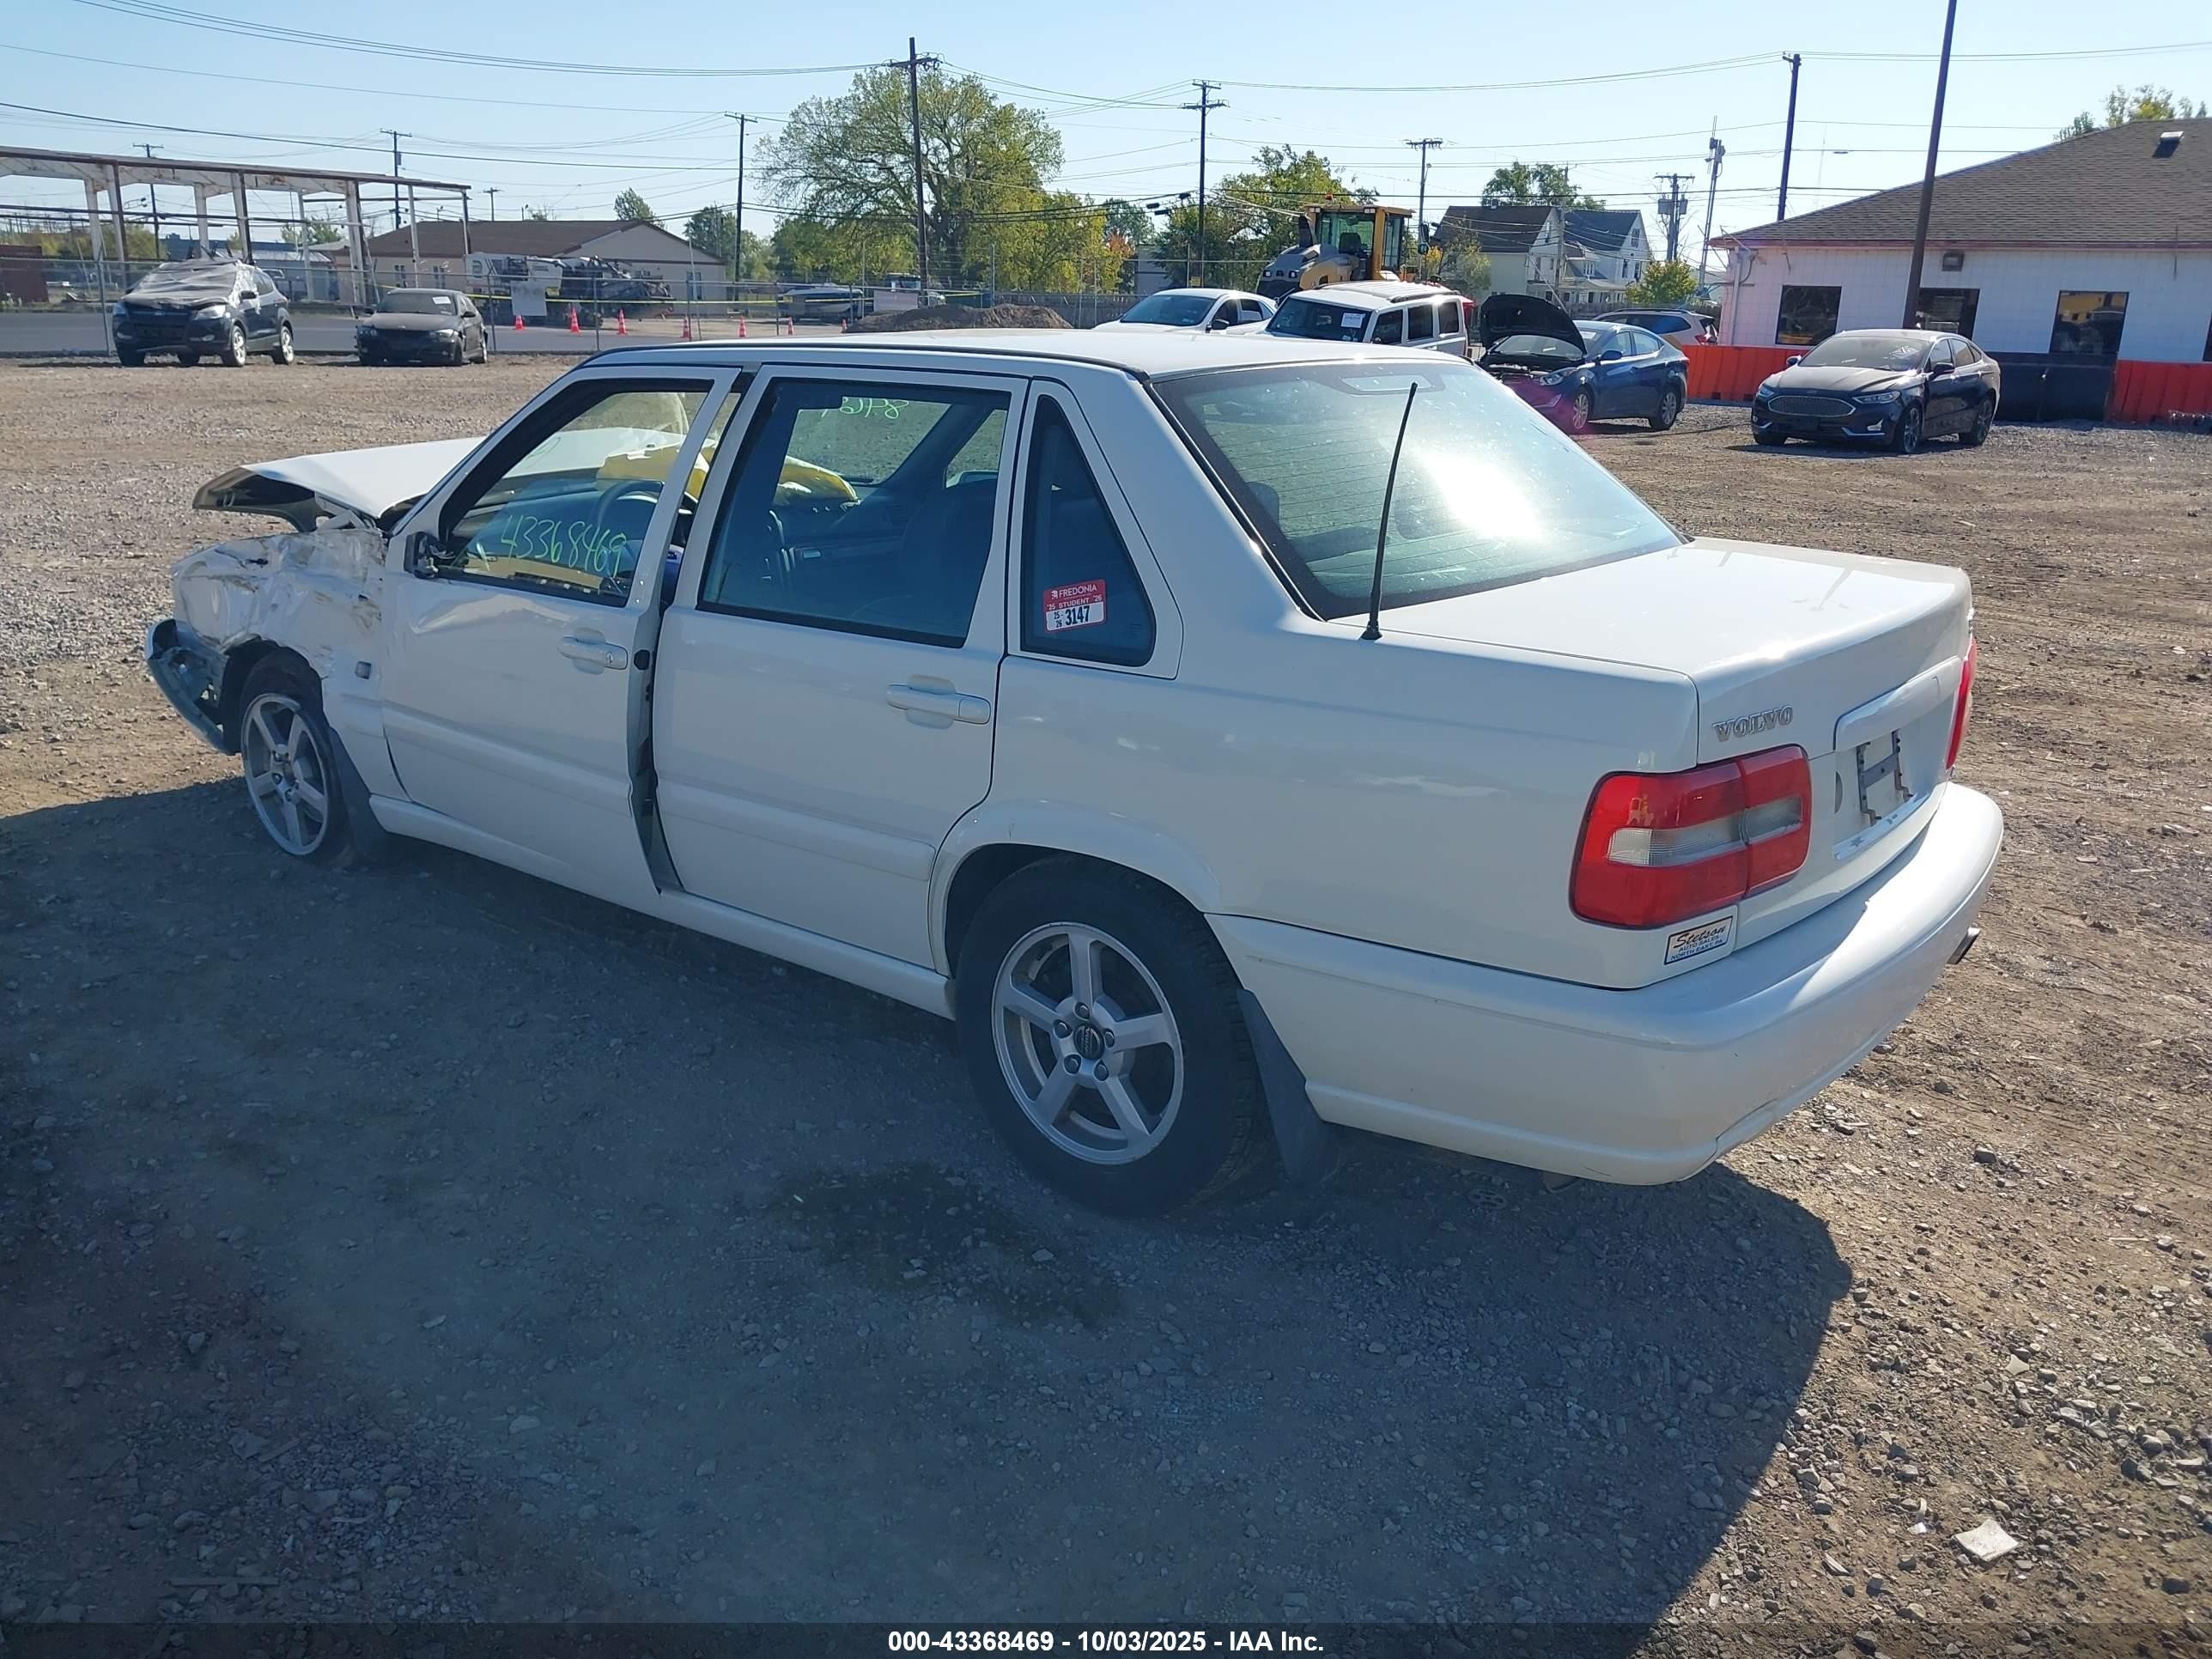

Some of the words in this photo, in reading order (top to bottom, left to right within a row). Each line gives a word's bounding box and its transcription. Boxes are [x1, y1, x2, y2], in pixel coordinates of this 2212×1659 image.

[501, 514, 627, 578] 43368469
[1059, 584, 1097, 598] FREDONIA
[1059, 598, 1090, 609] STUDENT
[1066, 605, 1090, 625] 3147
[1711, 705, 1793, 742] VOLVO
[1673, 926, 1726, 949] Stetson
[1679, 943, 1698, 952] AUTO
[1698, 936, 1719, 945] SALES
[1670, 950, 1694, 960] NORTH
